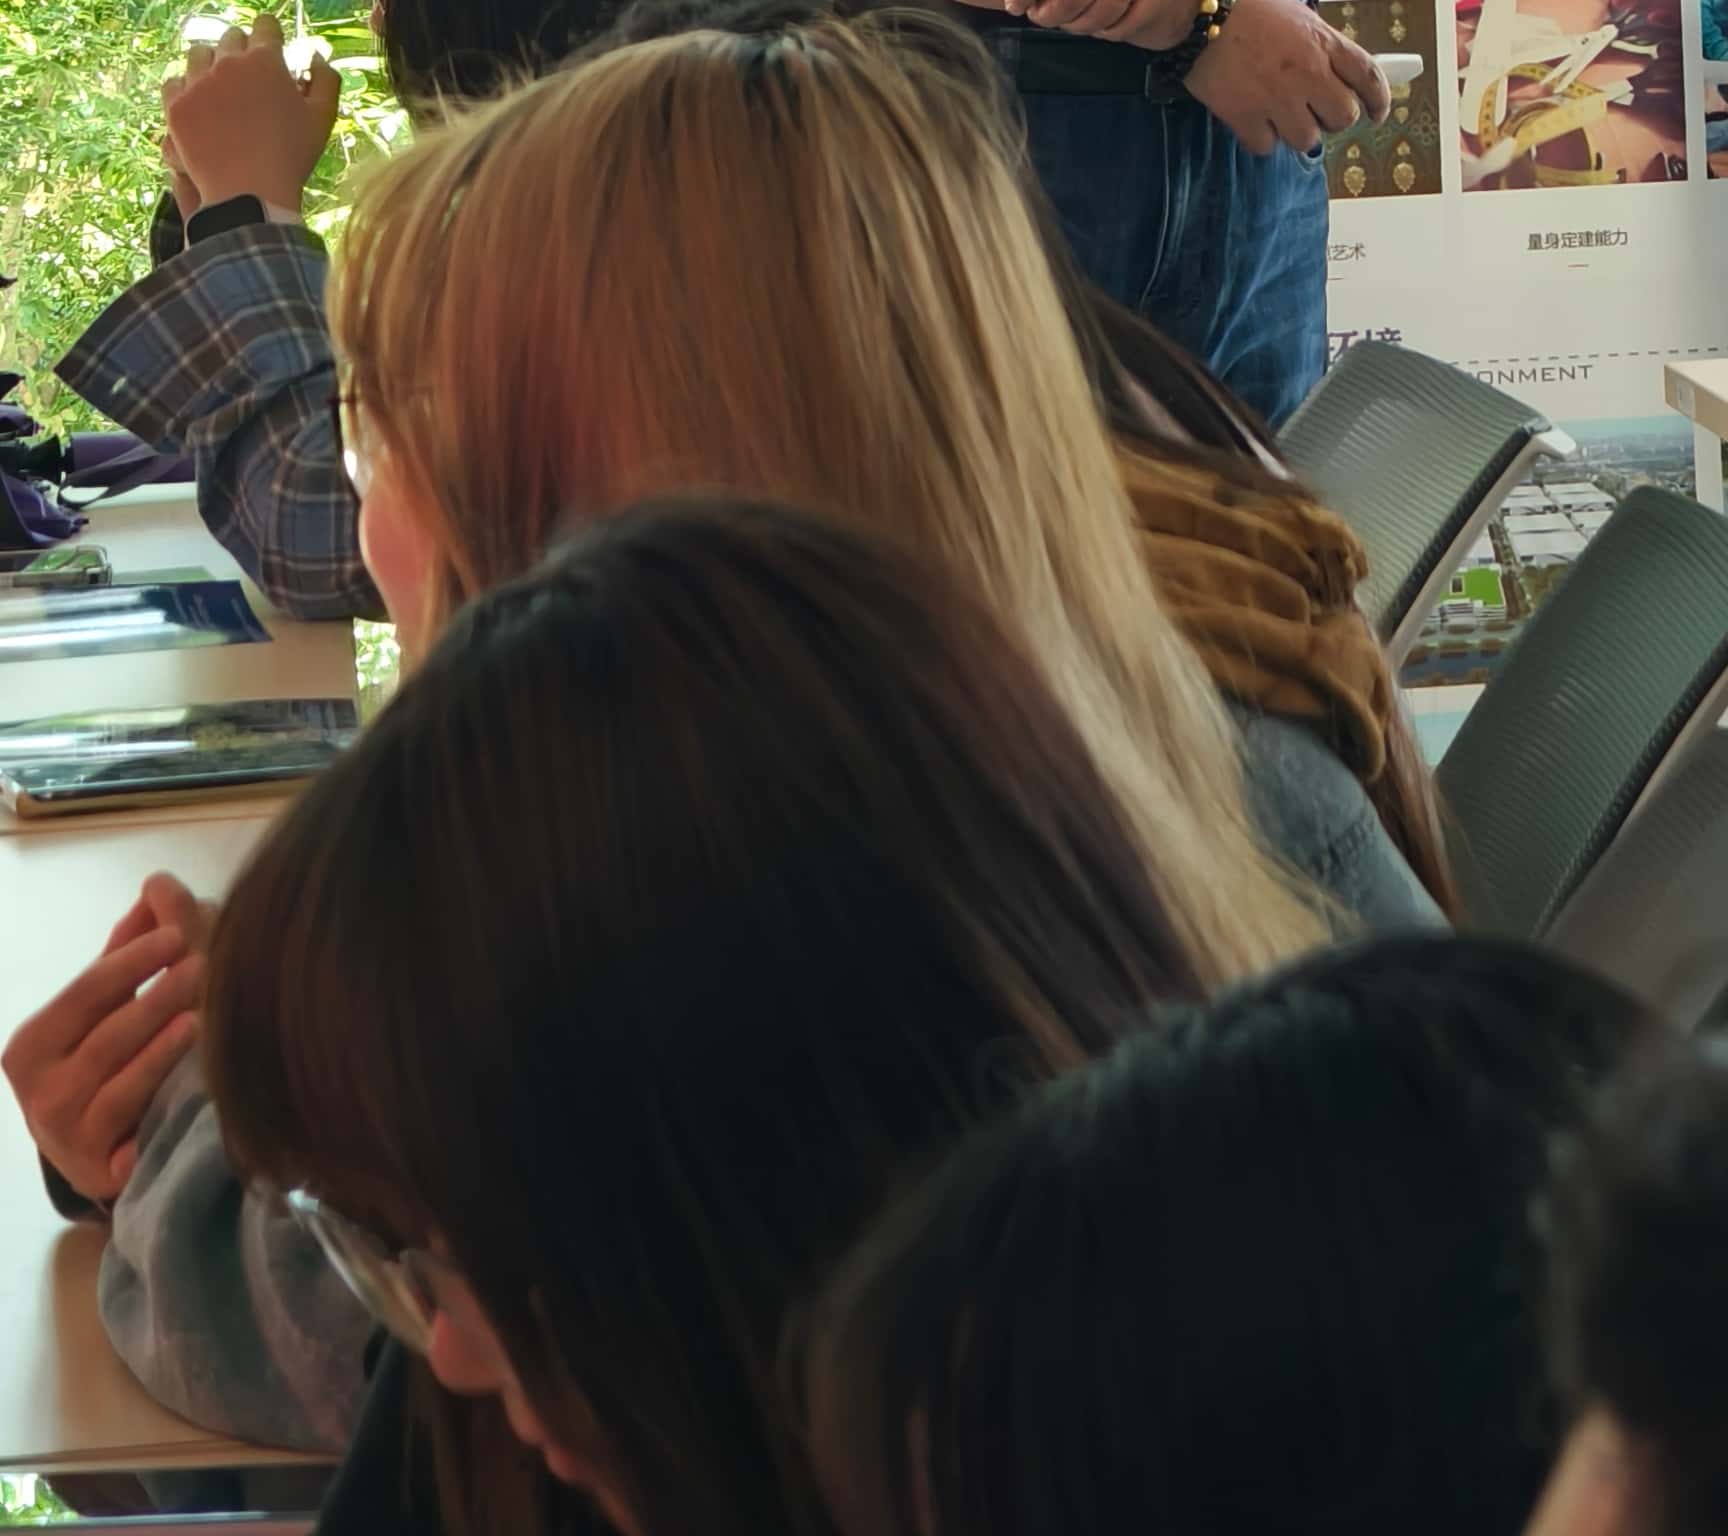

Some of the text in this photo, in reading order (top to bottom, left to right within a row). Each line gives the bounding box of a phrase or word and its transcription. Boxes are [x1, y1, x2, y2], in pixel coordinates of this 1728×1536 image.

[1528, 228, 1629, 251] 量身定建能力
[1327, 243, 1367, 262] 艺术
